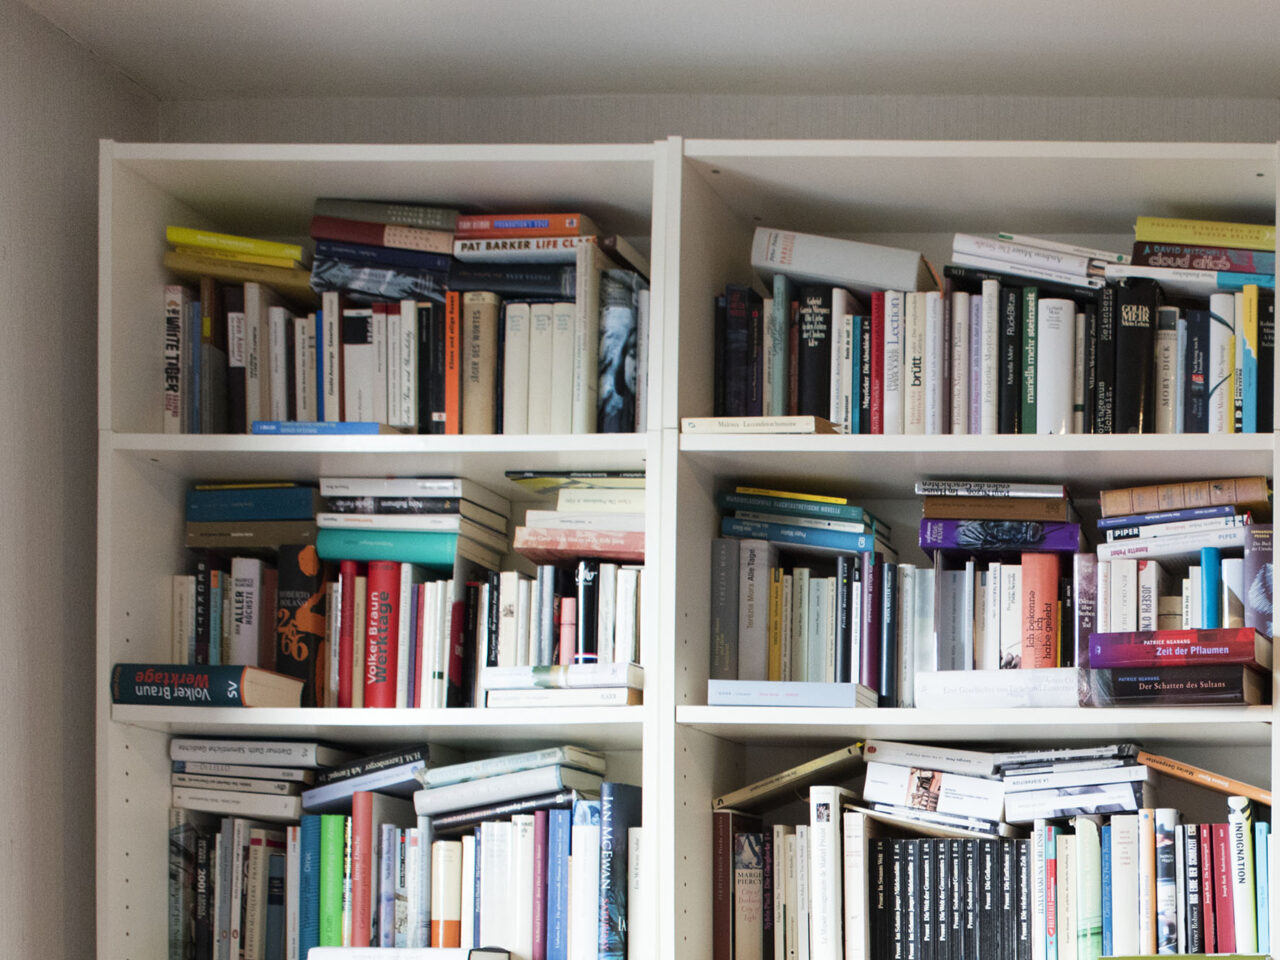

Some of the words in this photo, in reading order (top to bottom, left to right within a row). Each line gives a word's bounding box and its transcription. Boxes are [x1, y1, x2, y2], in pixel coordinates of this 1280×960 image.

[461, 242, 481, 252] PAT
[486, 240, 530, 251] BARKER
[537, 239, 558, 249] LIFE
[1154, 245, 1180, 254] DAVID
[1149, 252, 1190, 268] cloud
[886, 297, 900, 345] Lection
[1024, 293, 1035, 337] steinzeit
[1121, 304, 1149, 313] GOLDA
[1121, 312, 1149, 322] MEIR
[165, 316, 180, 351] WHITE
[472, 310, 482, 341] WORTES
[472, 344, 481, 358] DES
[1025, 339, 1035, 364] mehr
[164, 354, 180, 392] TIGER
[471, 357, 481, 383] JÄGER
[911, 355, 922, 387] brütt
[1161, 345, 1170, 407] MOBY-DICK
[1024, 366, 1035, 403] mariella
[1114, 528, 1139, 538] PIPER
[747, 549, 757, 566] Tage
[746, 567, 755, 581] Alle
[746, 583, 755, 602] Mora
[1142, 584, 1152, 613] JOSEPH
[234, 591, 244, 624] ALLER
[244, 591, 253, 625] HÖCHSTE
[368, 591, 378, 636] Braun
[1026, 591, 1036, 631] bekenne
[1043, 602, 1054, 632] gelebt
[1035, 617, 1044, 631] ich
[375, 591, 392, 684] Werktage
[1026, 633, 1035, 648] Ich
[1043, 634, 1052, 660] habe
[367, 639, 378, 685] Volker
[1156, 647, 1173, 656] Zeit
[1174, 647, 1188, 656] der
[1189, 645, 1229, 656] Pflaumen
[136, 669, 210, 688] Werktage
[227, 681, 238, 698] SV
[1138, 682, 1152, 690] Der
[1154, 681, 1184, 690] Schatten
[1186, 681, 1198, 689] des
[1199, 680, 1226, 689] Sultans
[136, 684, 174, 699] Braun
[174, 686, 211, 701] Volker
[602, 796, 613, 822] IAN
[1235, 821, 1246, 884] INDIGNATION
